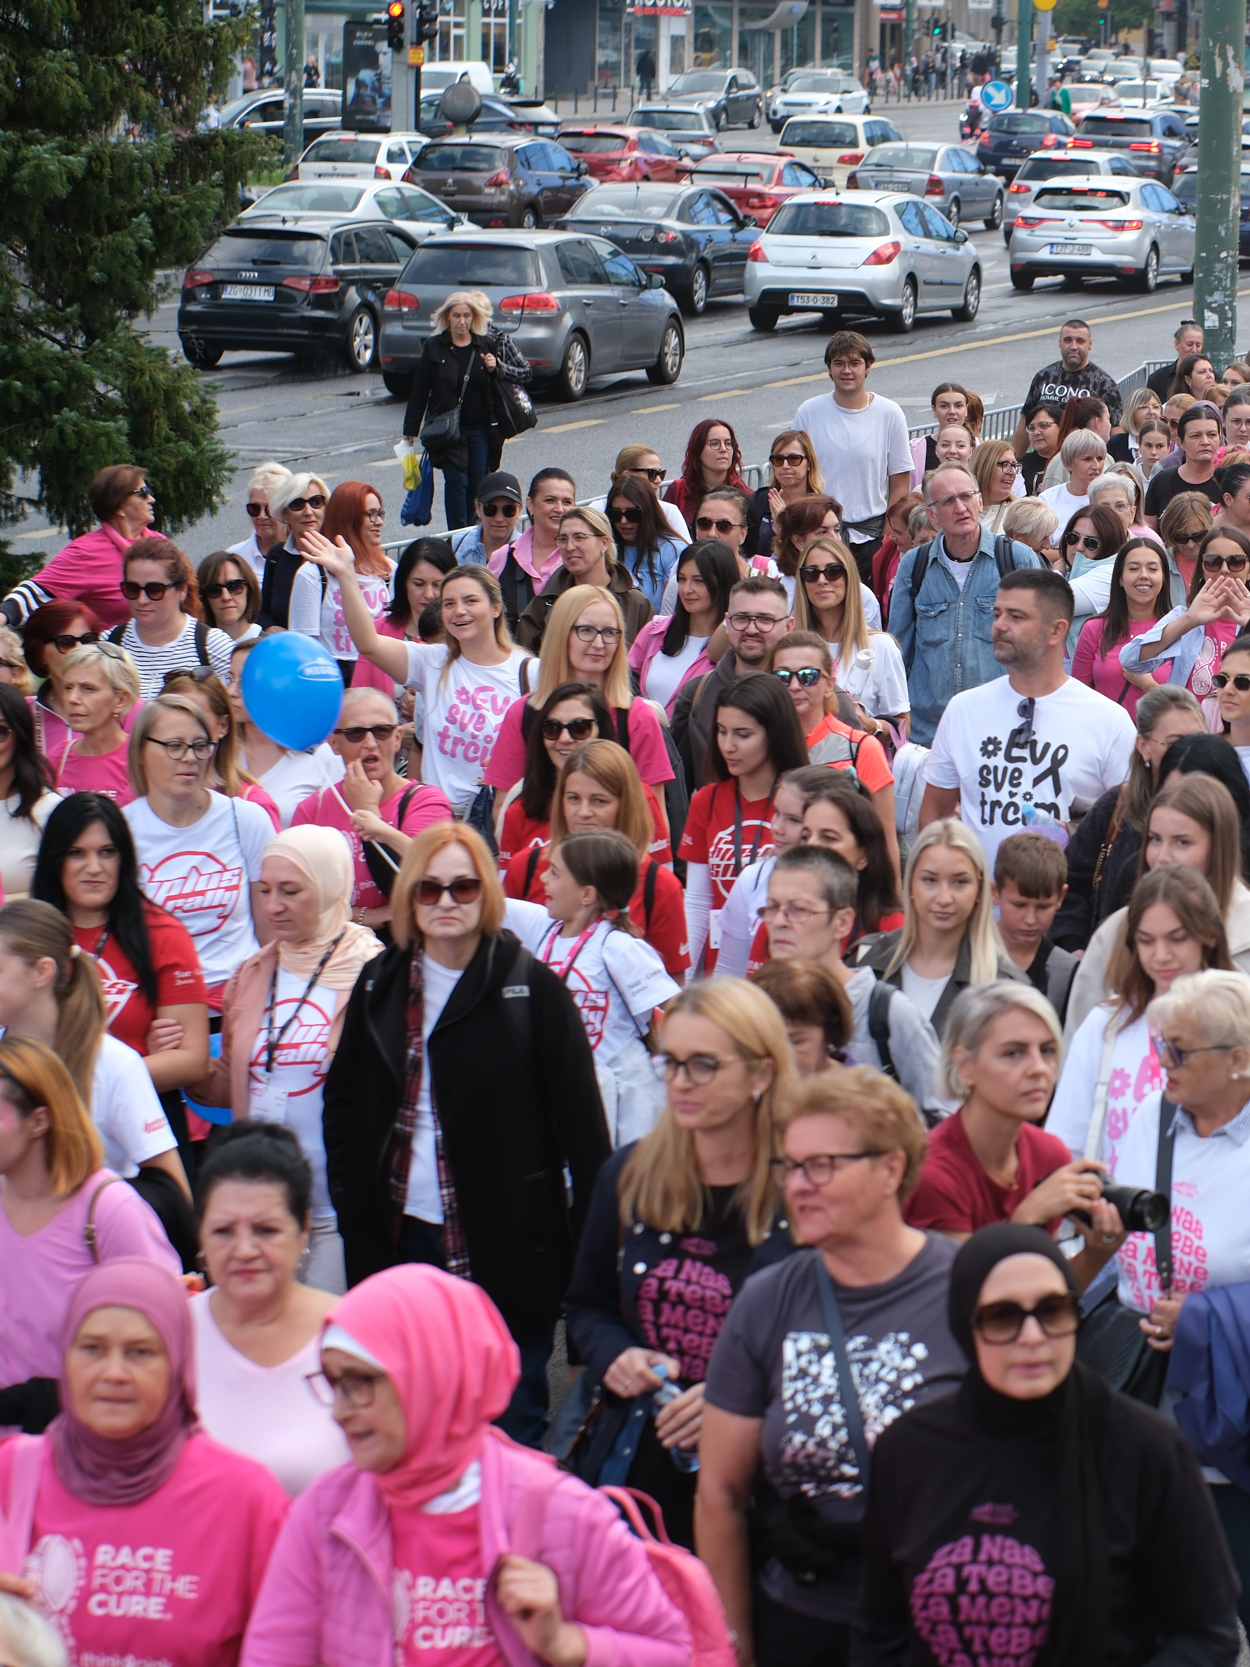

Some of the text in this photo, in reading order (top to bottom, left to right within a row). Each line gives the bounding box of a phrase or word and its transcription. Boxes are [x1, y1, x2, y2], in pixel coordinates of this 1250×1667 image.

[445, 702, 486, 734] sve
[978, 764, 1023, 793] sve
[93, 1543, 175, 1572] RACE
[90, 1568, 200, 1600] FOR THE
[413, 1600, 470, 1626] FOR
